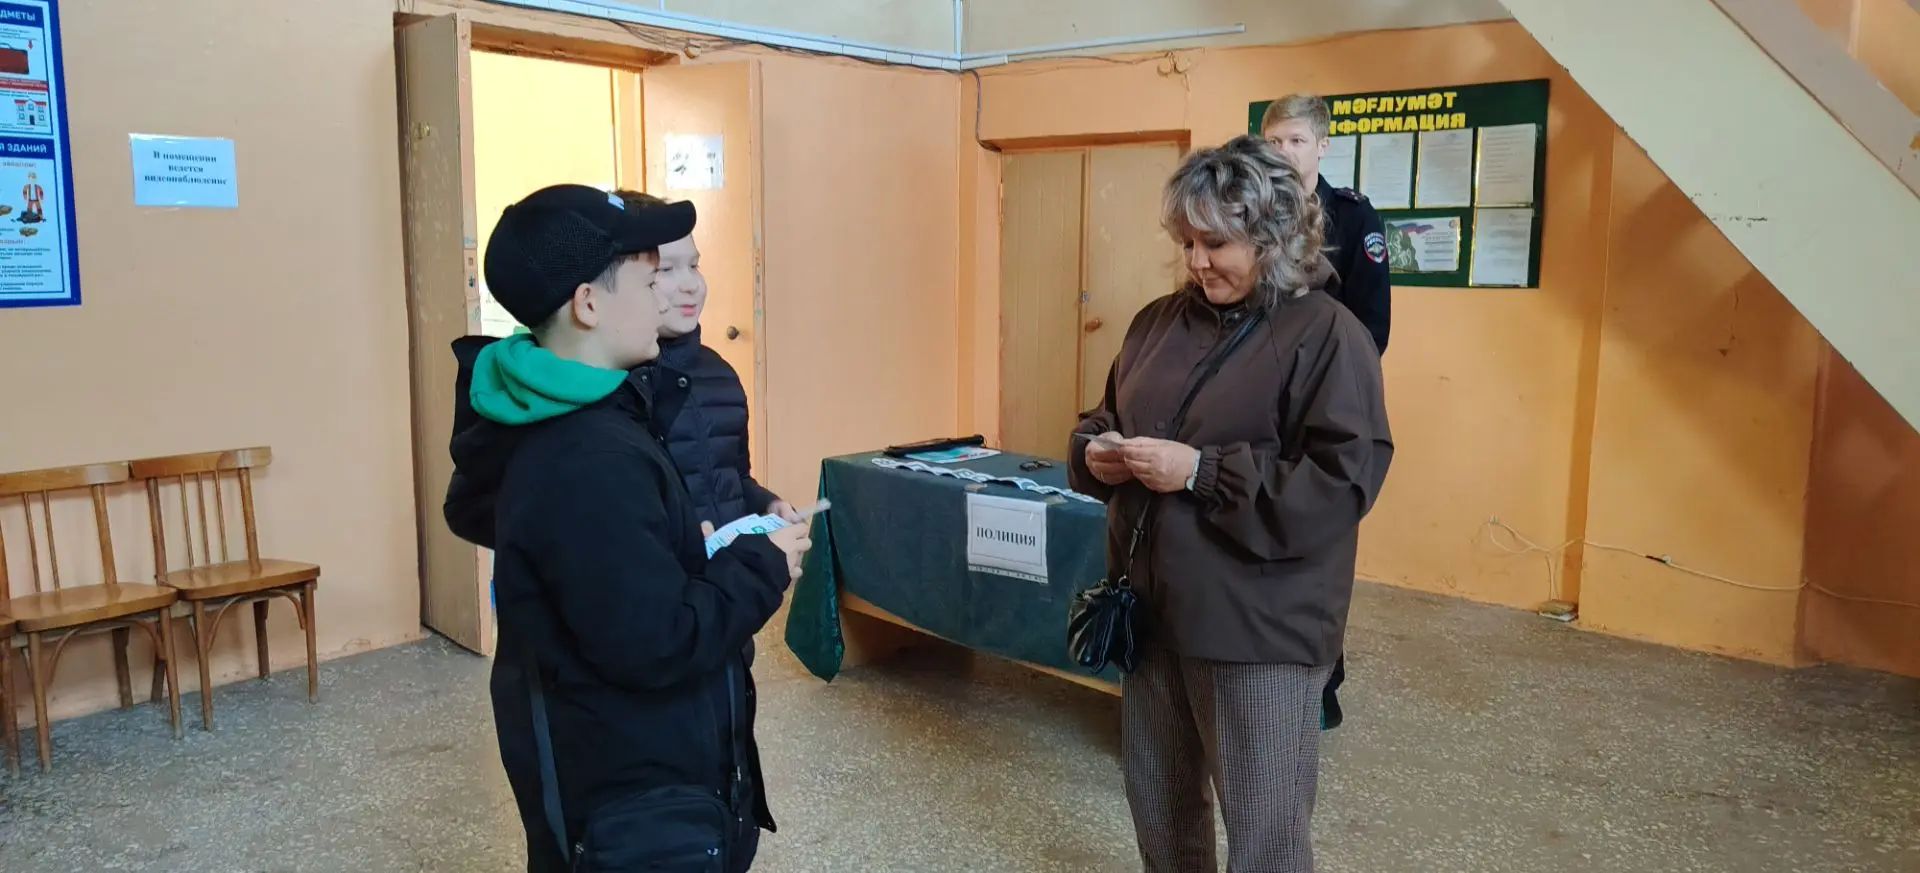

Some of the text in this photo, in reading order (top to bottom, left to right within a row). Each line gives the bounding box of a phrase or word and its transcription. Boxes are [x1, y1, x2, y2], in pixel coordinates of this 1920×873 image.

[1329, 113, 1466, 135] ФОРМАЦИЯ
[163, 153, 217, 163] помещении
[144, 175, 227, 185] видеонаблюдение
[976, 527, 1036, 547] ПОЛИЦИЯ
